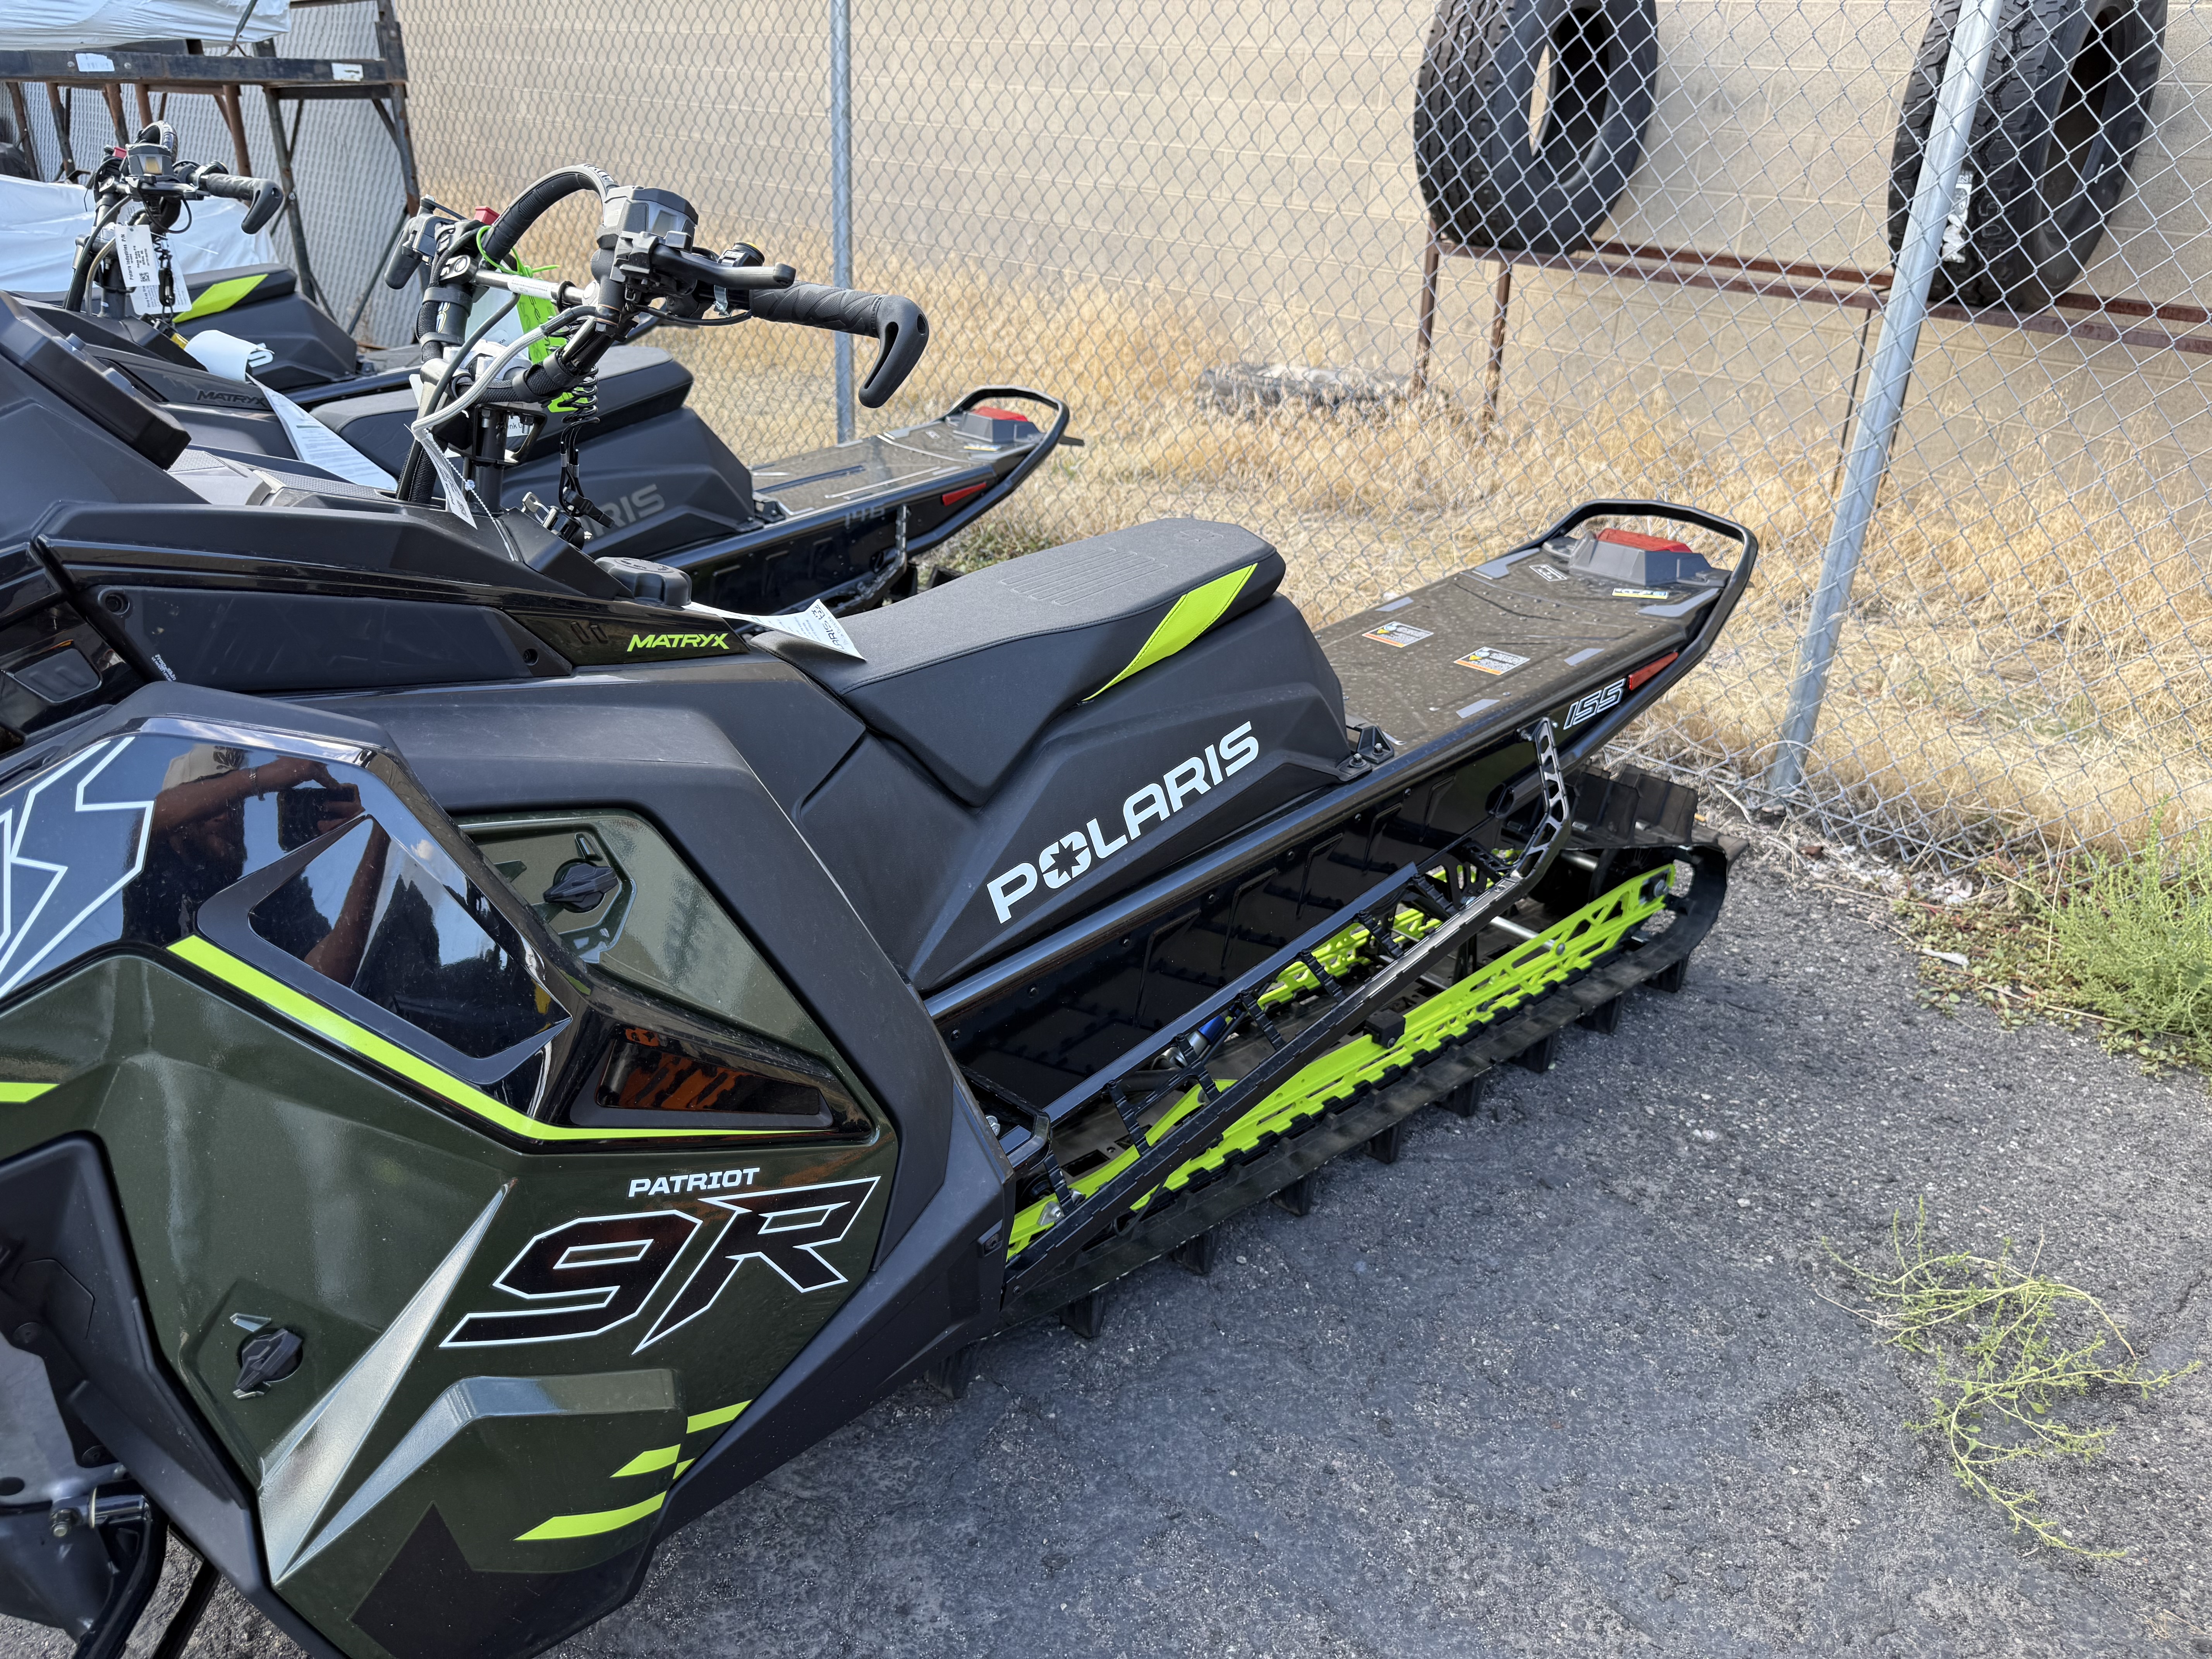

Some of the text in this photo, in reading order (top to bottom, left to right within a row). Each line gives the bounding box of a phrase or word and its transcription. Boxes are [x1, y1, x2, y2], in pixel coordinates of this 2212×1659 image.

[123, 244, 131, 265] Industries
[197, 390, 268, 408] MATRYX
[627, 632, 730, 652] MATRYX
[823, 620, 846, 650] LARIS
[1563, 678, 1626, 730] 155
[986, 721, 1259, 924] POLARIS
[628, 1167, 760, 1199] PATRIOT
[439, 1175, 882, 1356] 9R
